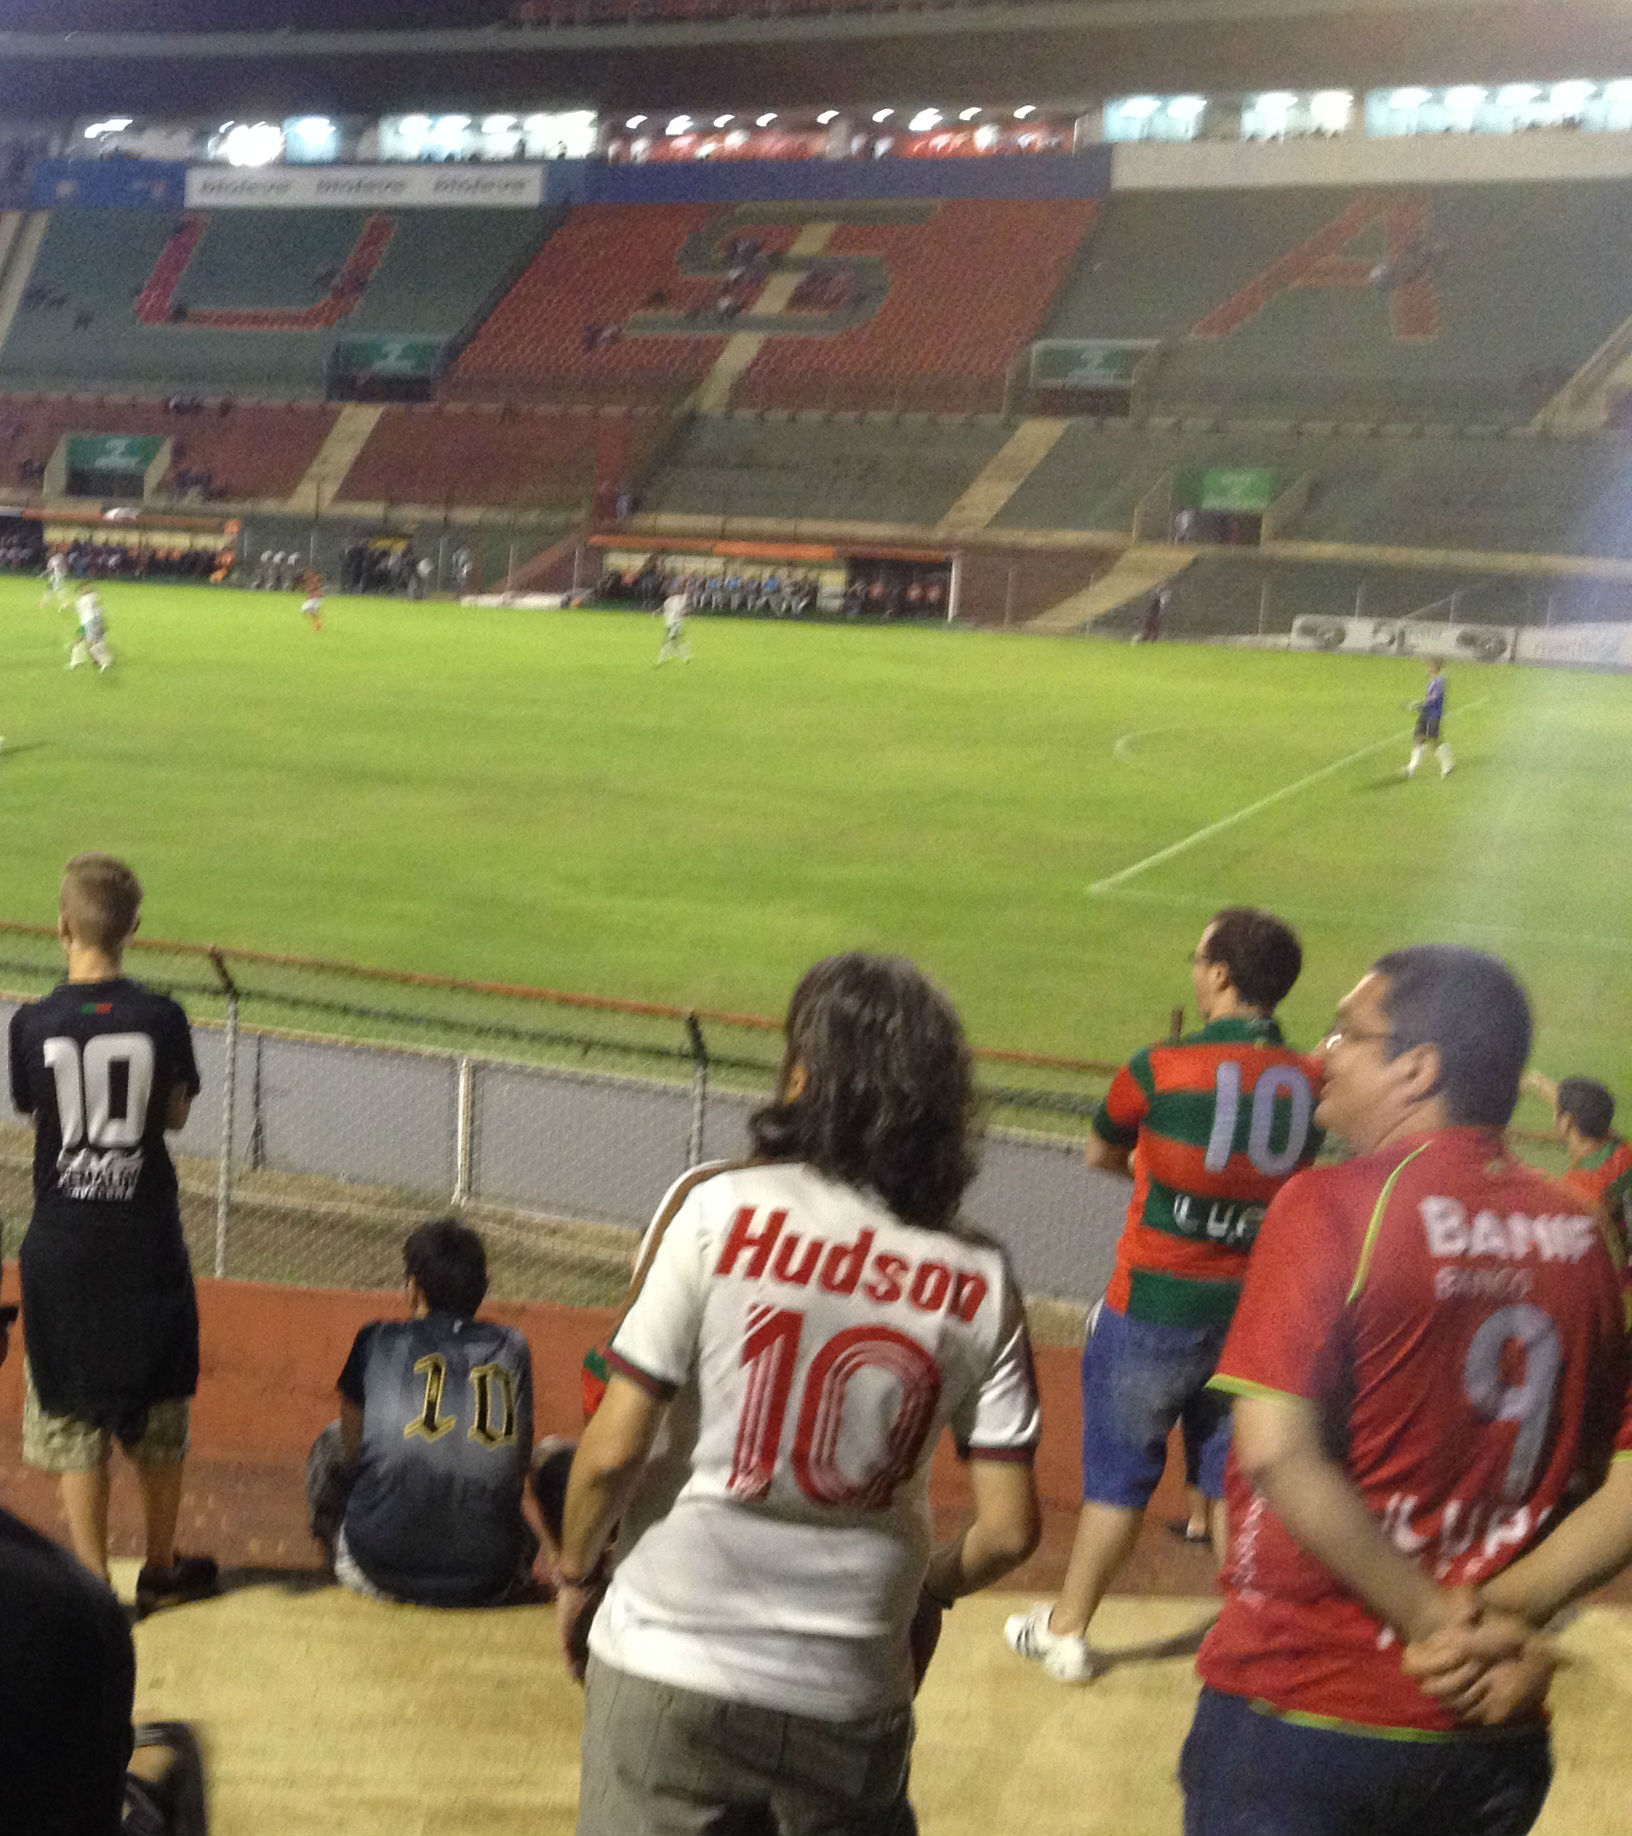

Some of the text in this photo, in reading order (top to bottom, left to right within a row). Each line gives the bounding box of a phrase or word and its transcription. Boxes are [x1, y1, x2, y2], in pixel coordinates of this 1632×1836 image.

[43, 1031, 155, 1149] 10
[1203, 1059, 1314, 1177] 10
[714, 1205, 988, 1323] Hudson
[1171, 1193, 1266, 1239] LUP
[403, 1352, 519, 1450] 10
[725, 1302, 943, 1516] 10
[1464, 1302, 1563, 1502] 9
[1380, 1491, 1553, 1559] LUP
